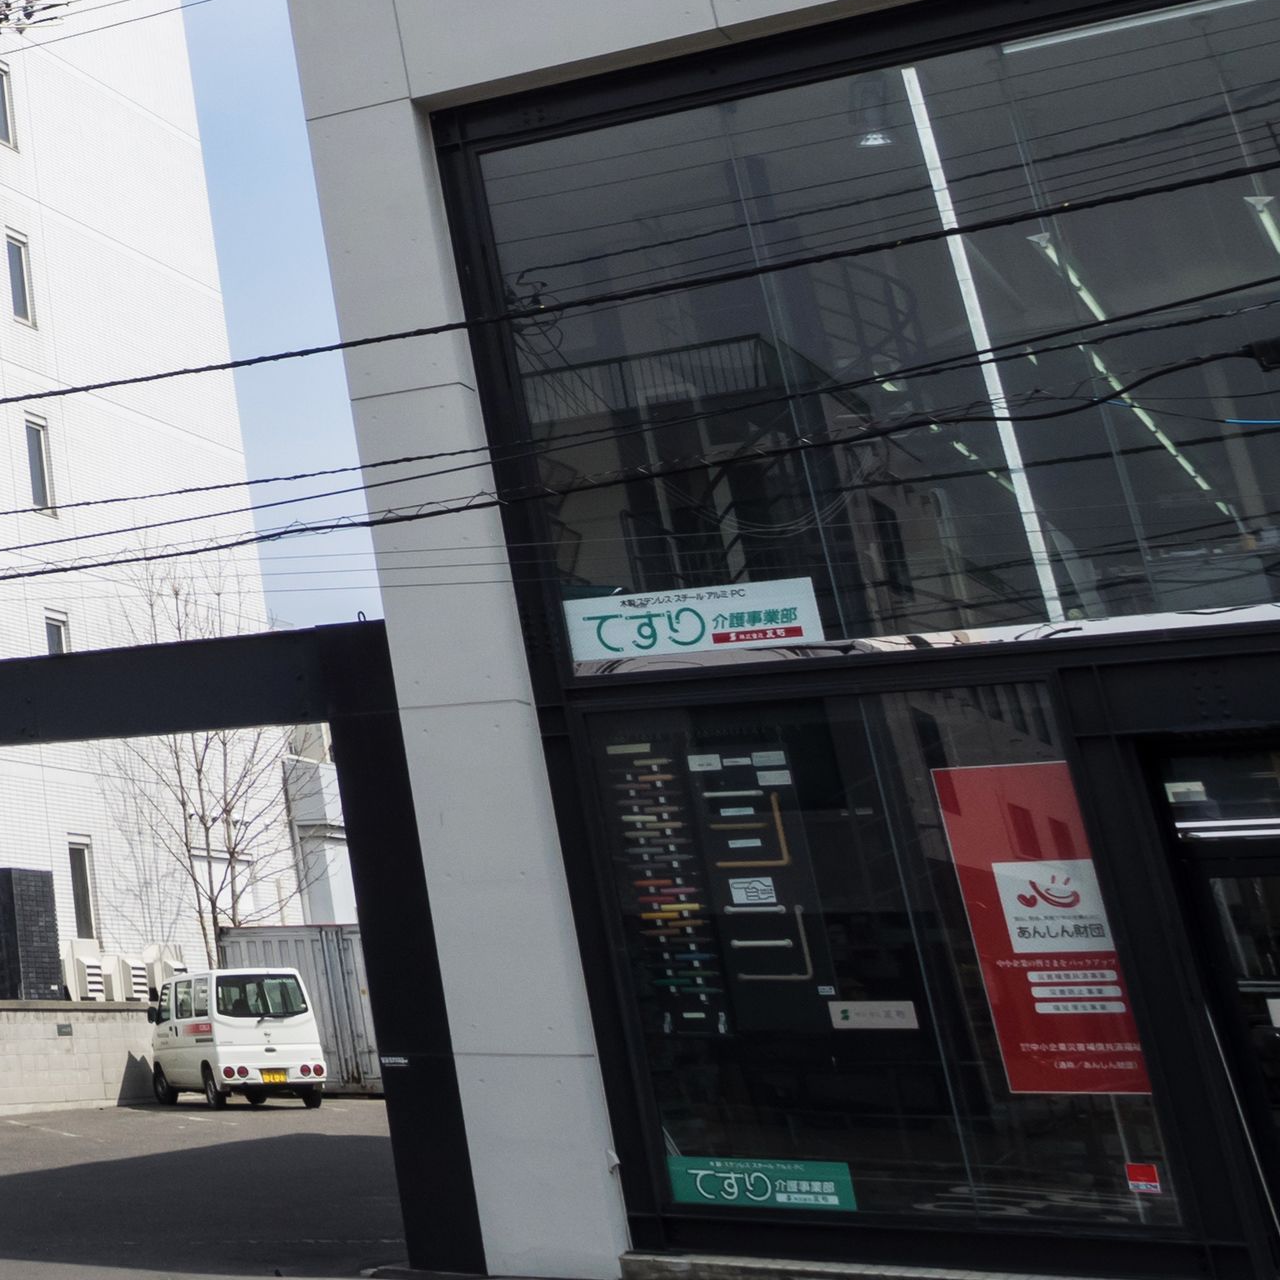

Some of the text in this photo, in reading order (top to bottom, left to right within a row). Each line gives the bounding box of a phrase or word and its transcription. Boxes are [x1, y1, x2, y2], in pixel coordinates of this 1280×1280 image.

[582, 606, 798, 652] てすり 介護事業部
[1016, 923, 1106, 939] あんしん財団
[688, 1170, 835, 1201] てすり 介護事業部
